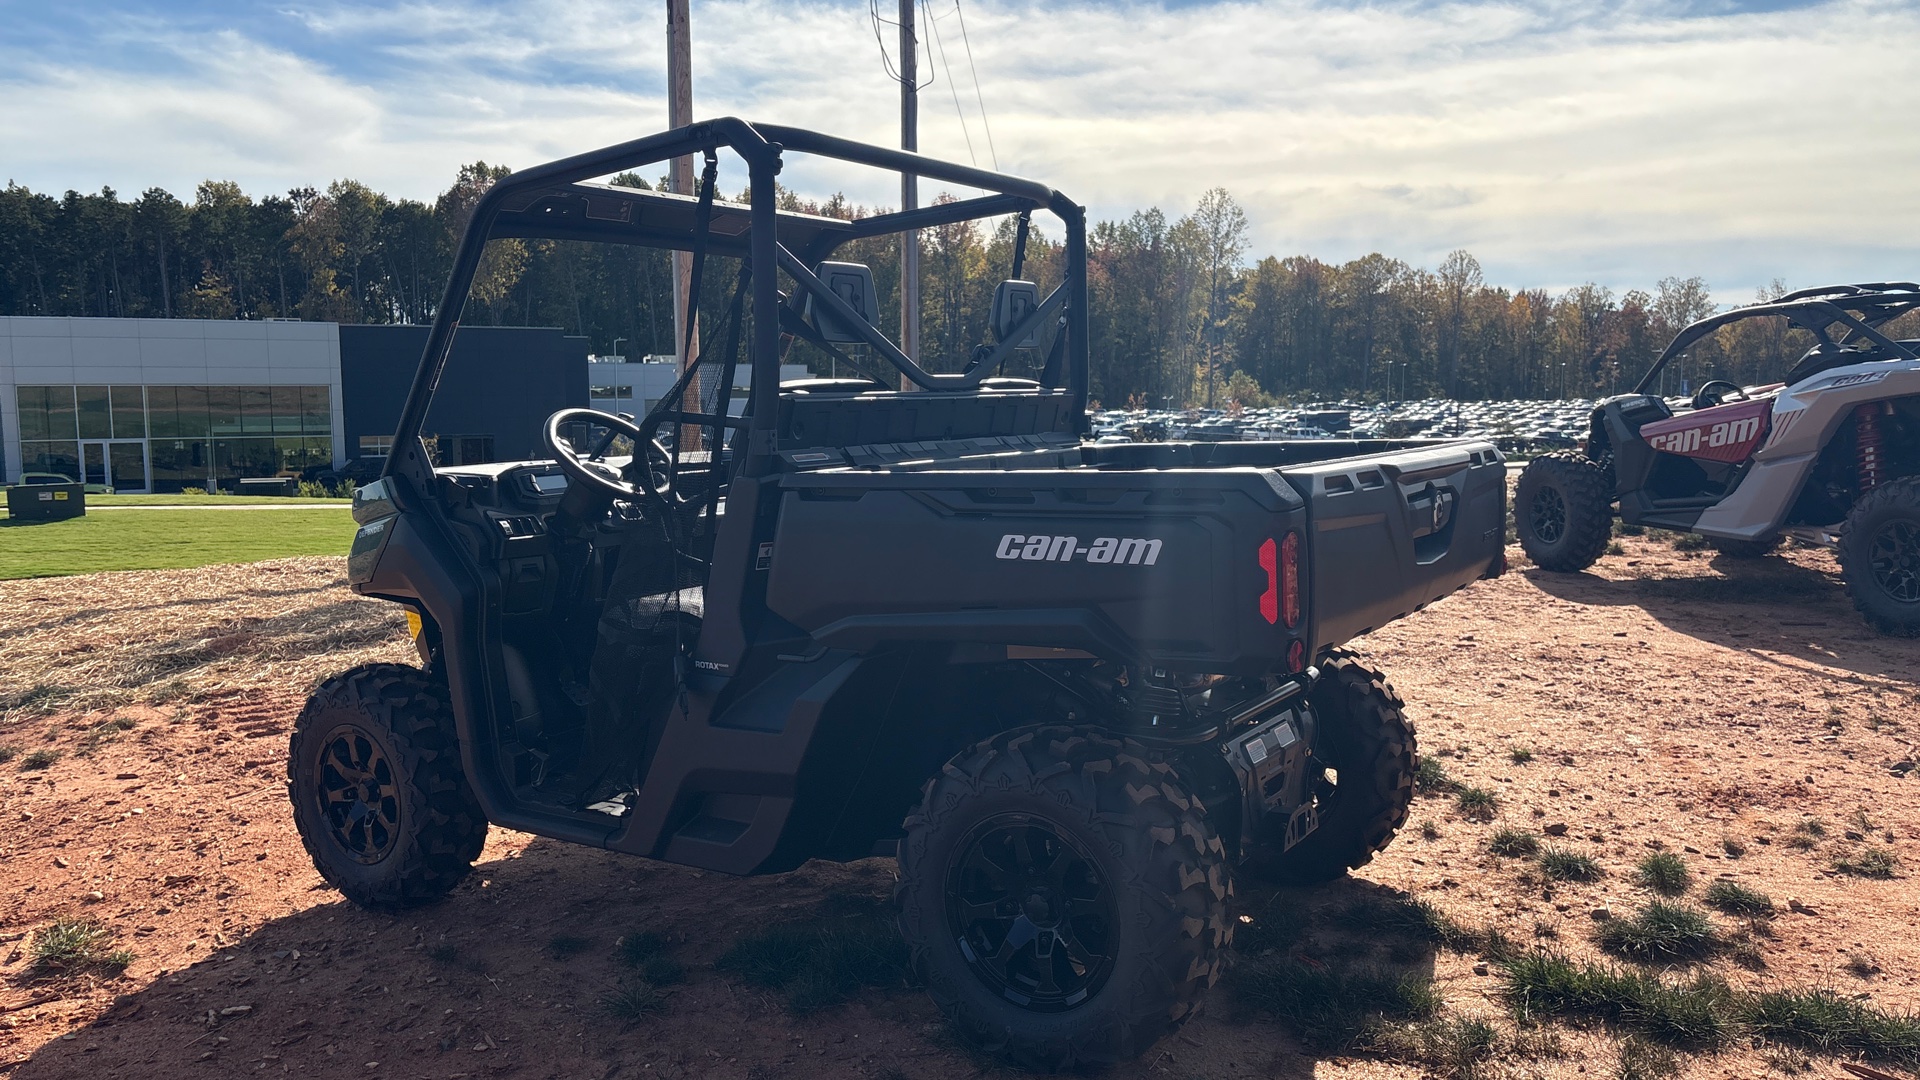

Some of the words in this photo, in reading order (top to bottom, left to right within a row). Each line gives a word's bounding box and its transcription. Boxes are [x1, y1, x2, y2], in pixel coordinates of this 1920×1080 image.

[1650, 417, 1760, 453] can-am
[995, 534, 1163, 566] can-am
[695, 660, 719, 670] ROTAX
